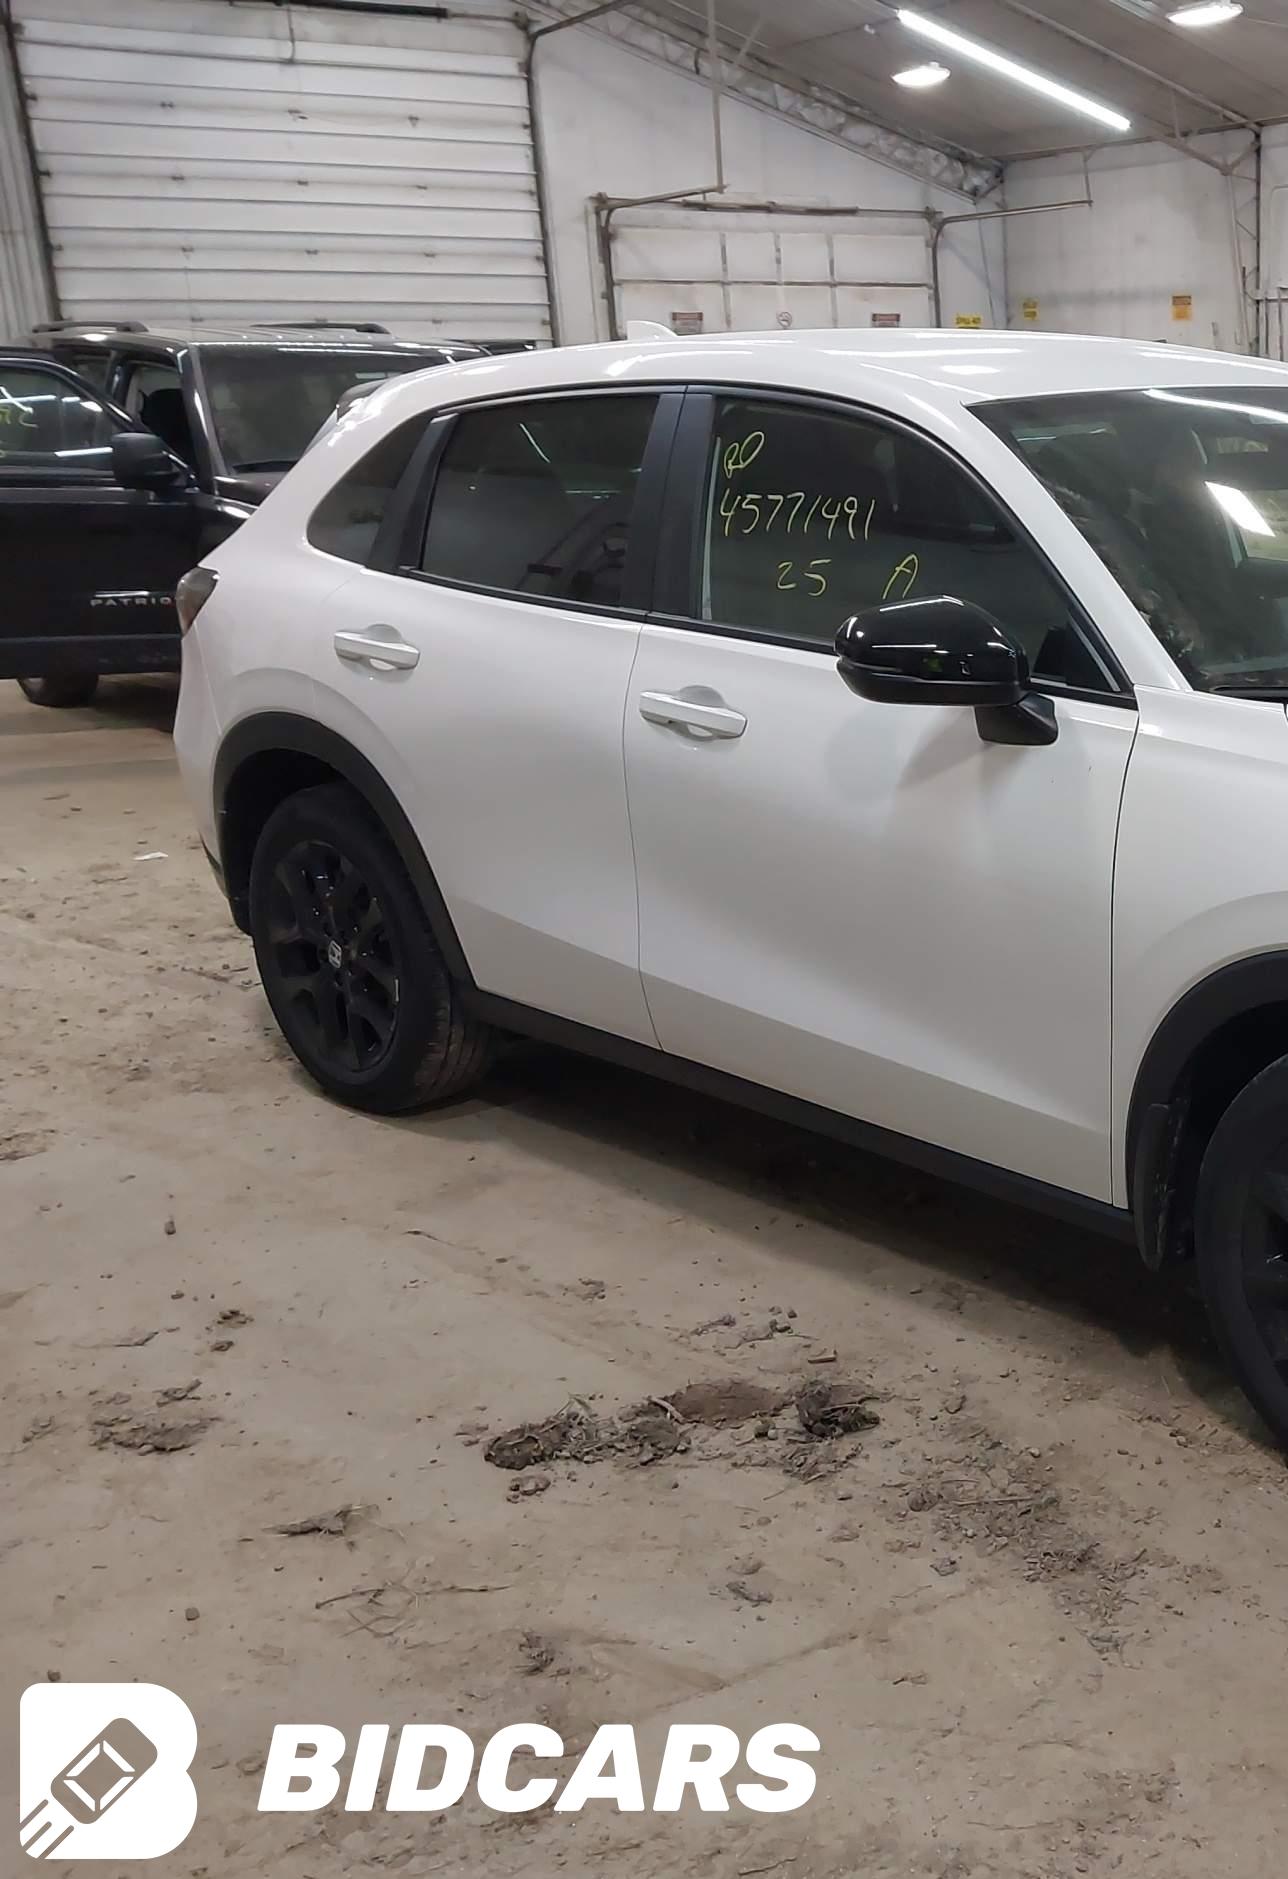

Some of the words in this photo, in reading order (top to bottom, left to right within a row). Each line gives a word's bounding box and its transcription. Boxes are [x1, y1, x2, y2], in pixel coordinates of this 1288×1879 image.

[720, 488, 876, 541] 45771491
[777, 559, 832, 597] 25
[90, 596, 174, 607] PATRIO
